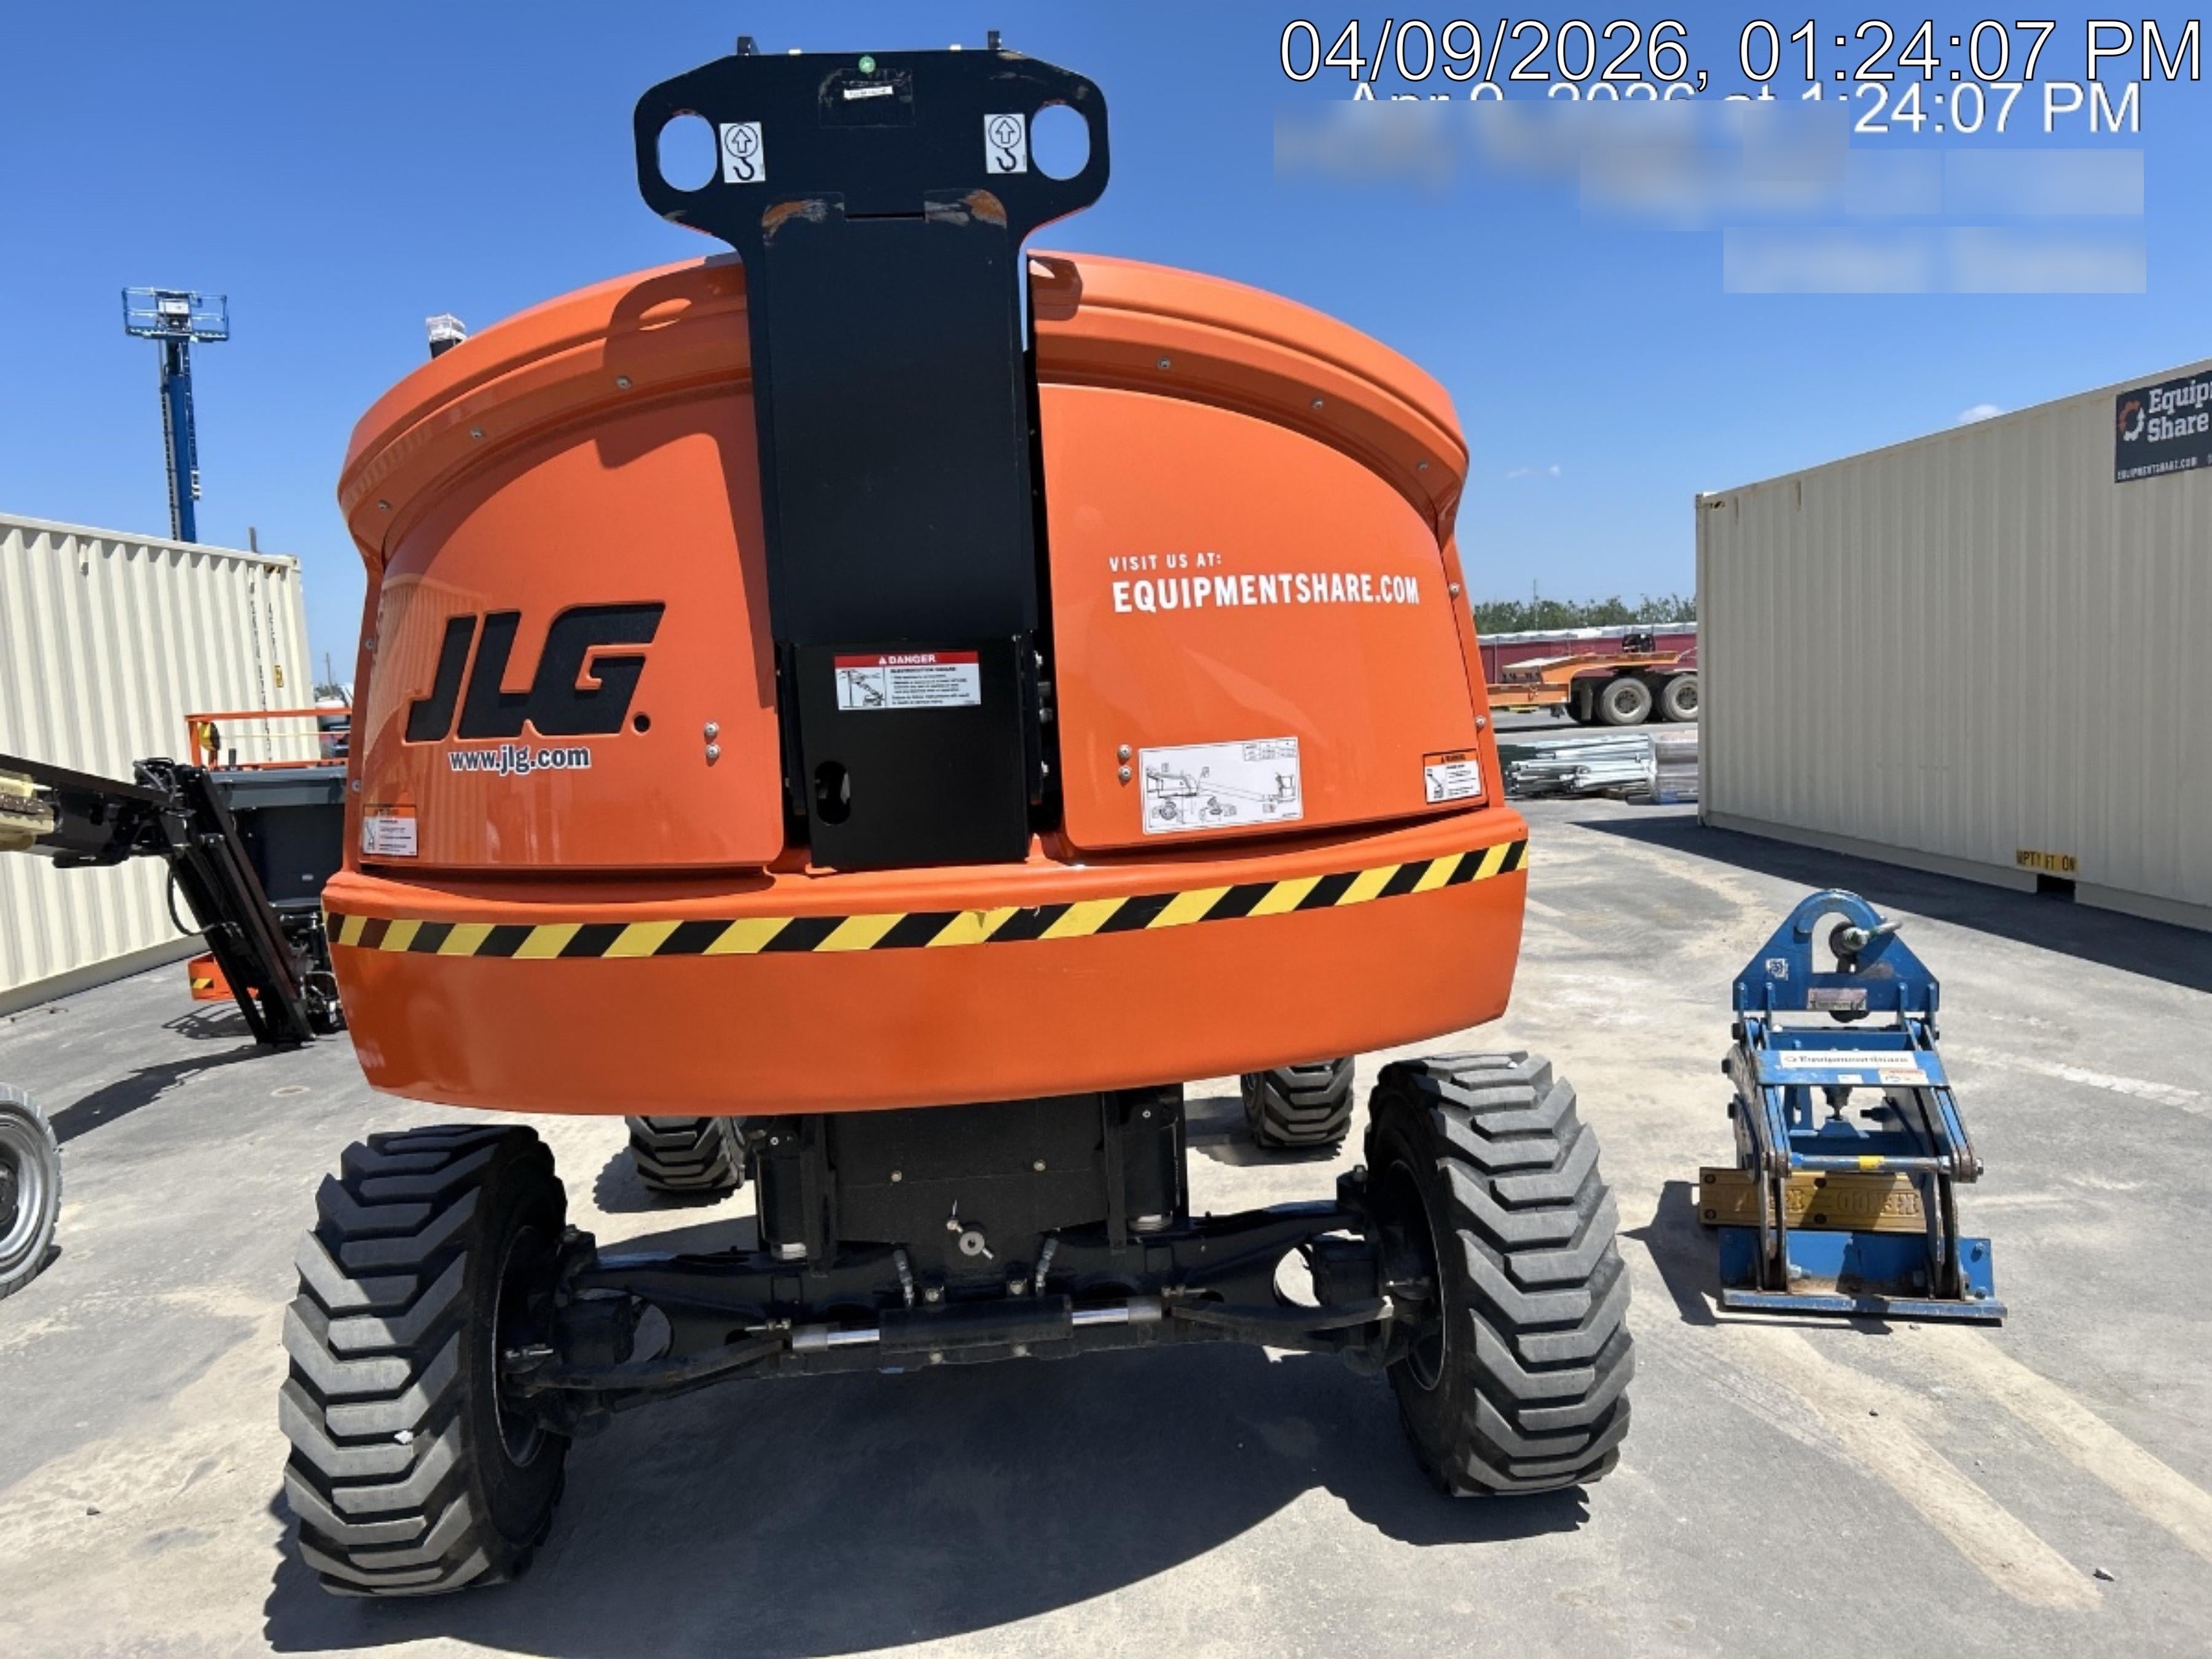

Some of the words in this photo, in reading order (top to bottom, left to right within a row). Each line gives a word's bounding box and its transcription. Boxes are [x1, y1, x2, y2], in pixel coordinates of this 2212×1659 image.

[2148, 379, 2212, 415] Equip
[2147, 412, 2209, 442] Share
[1108, 554, 1158, 572] VISIT
[1166, 554, 1188, 569] US
[1196, 552, 1222, 567] AT:
[1112, 573, 1420, 613] EQUIPMENTSHARE.COM
[888, 654, 936, 665] DANGER
[448, 745, 590, 774] www.jlg.com
